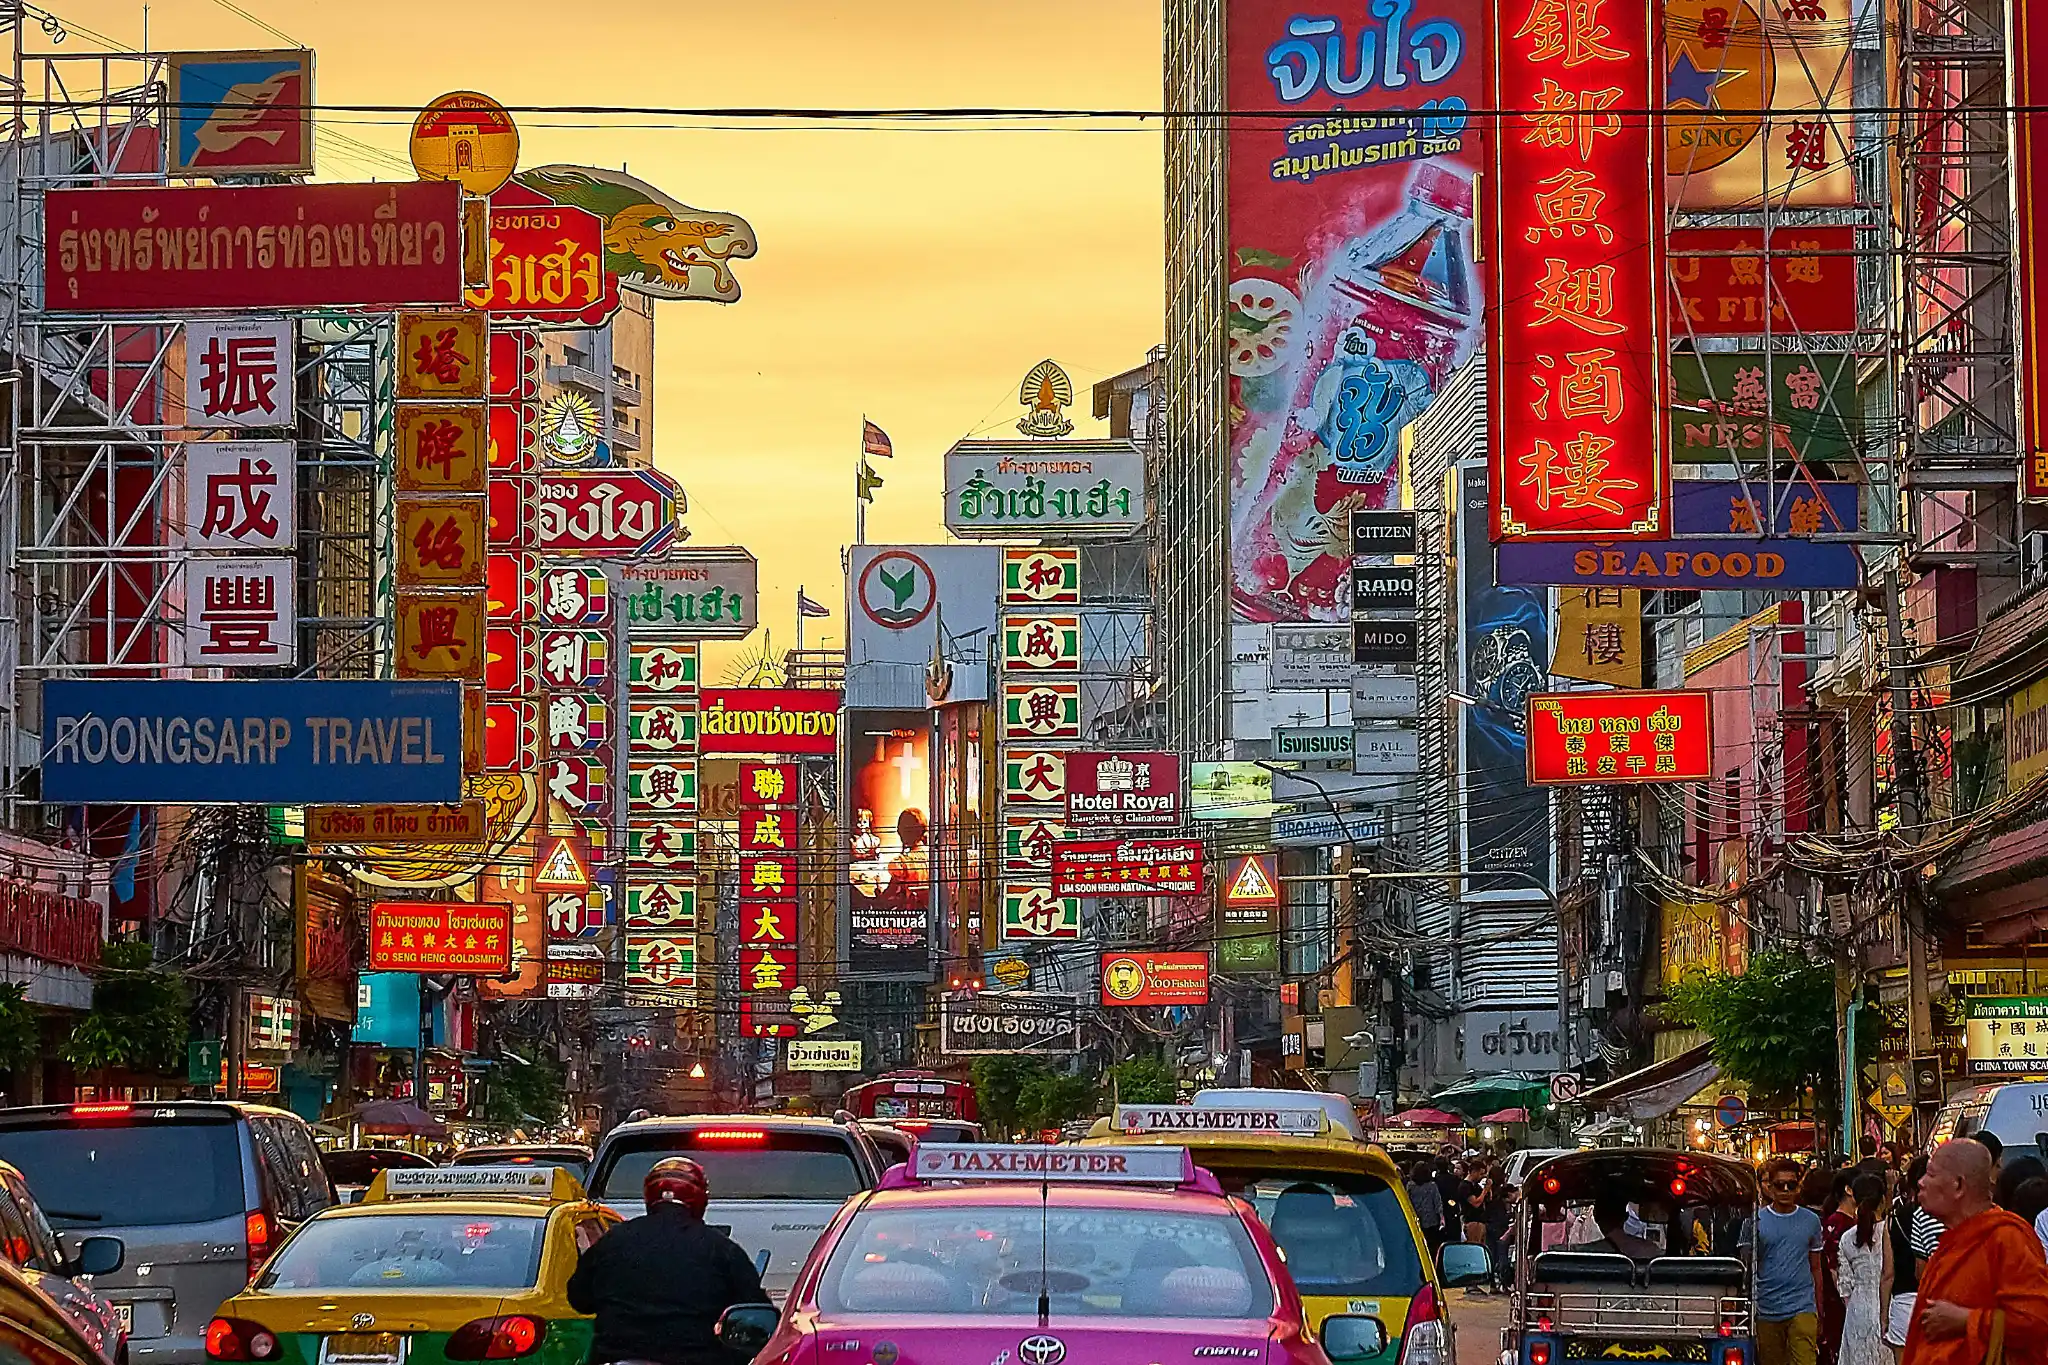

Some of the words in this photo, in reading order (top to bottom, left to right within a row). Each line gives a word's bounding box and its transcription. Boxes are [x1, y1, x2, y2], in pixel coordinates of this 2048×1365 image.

[1268, 0, 1461, 101] จับใจ
[1419, 96, 1467, 138] 10
[1680, 128, 1742, 147] SING
[59, 187, 446, 299] รุ่งทรัพย์การท่องเที่ยว
[1729, 240, 1822, 285] 魚翅
[1684, 423, 1791, 449] NEST
[997, 457, 1092, 475] ห้างขายทอง
[1356, 526, 1412, 539] CITIZEN
[1574, 551, 1785, 579] SEAFOOD
[1357, 579, 1413, 592] RADO
[1364, 633, 1407, 644] MIDO
[1553, 711, 1593, 733] ไทย
[1600, 716, 1640, 732] หลง
[56, 716, 291, 764] ROONGSARP
[306, 716, 445, 764] TRAVEL
[1370, 742, 1402, 751] BALL
[1070, 793, 1118, 809] Hotel
[1123, 793, 1174, 811] Royal
[1125, 813, 1174, 823] Chinatown
[1075, 883, 1097, 893] SOON
[1098, 882, 1120, 892] HENG
[377, 910, 440, 929] ห้างขายทอง
[376, 952, 389, 961] SO
[392, 952, 417, 962] SENG
[420, 953, 446, 963] HENG
[449, 953, 503, 964] GOLDSMITH
[1171, 979, 1205, 988] Fishball
[1998, 1042, 2048, 1058] 魚翅
[1974, 1061, 2001, 1072] CHINA
[2003, 1061, 2029, 1071] TOWN
[1147, 1111, 1279, 1130] TAXI-METER
[947, 1152, 1128, 1173] TAXI-METER
